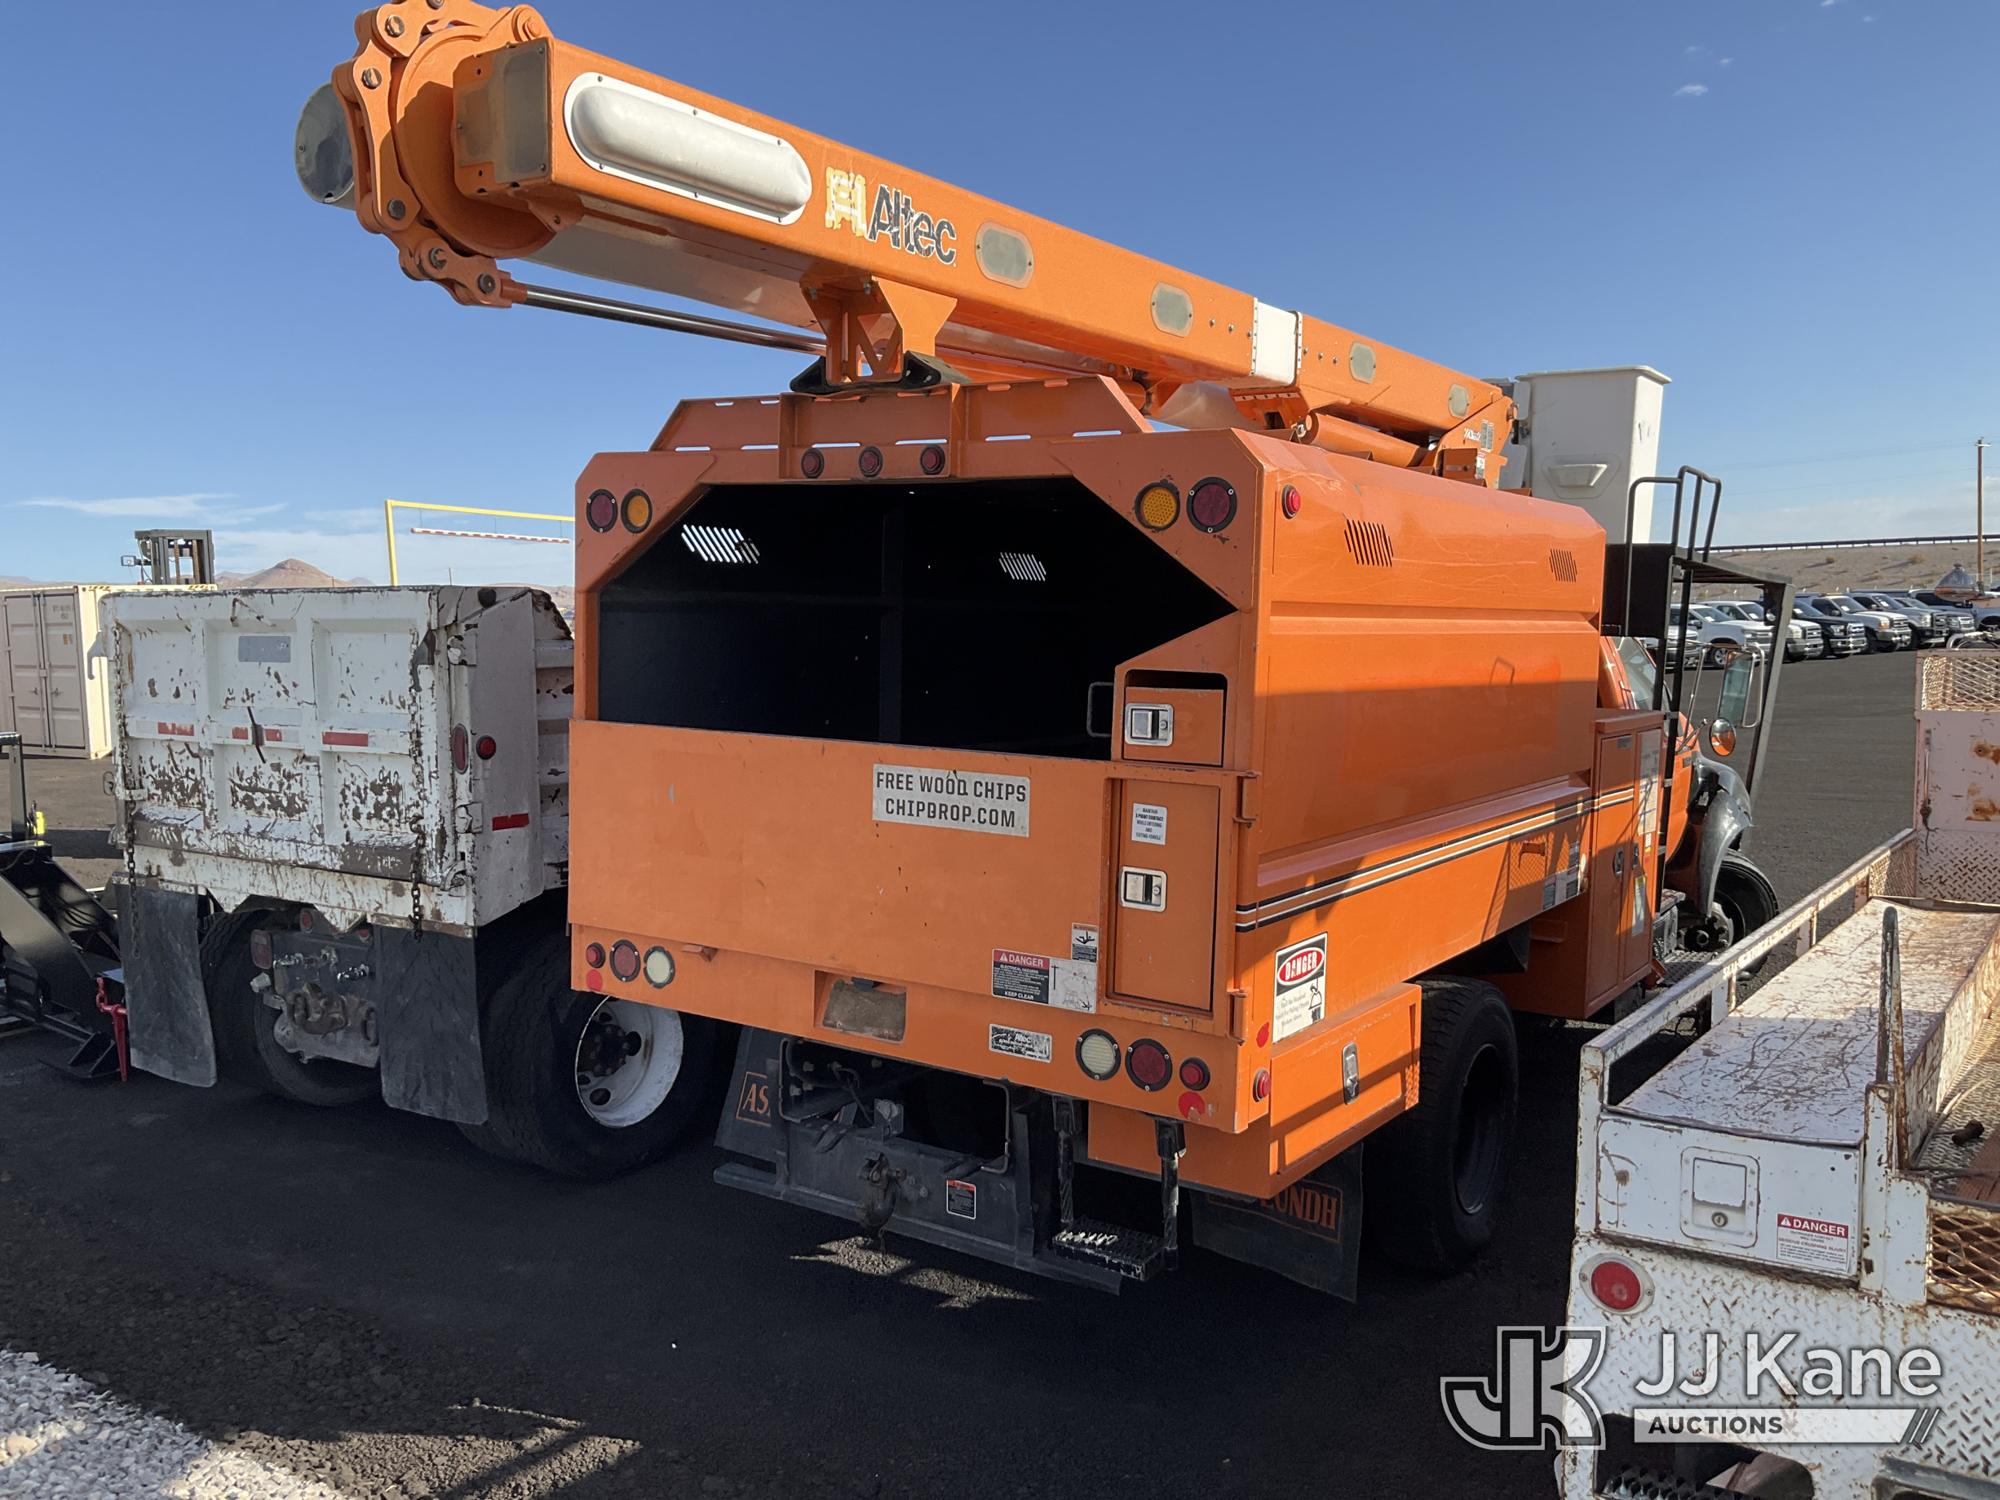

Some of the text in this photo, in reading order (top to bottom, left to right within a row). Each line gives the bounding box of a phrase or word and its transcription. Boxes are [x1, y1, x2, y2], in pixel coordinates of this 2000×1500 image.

[867, 184, 957, 265] Altec
[876, 772, 1026, 802] FREE WOOD CHIPS
[885, 798, 1015, 828] CHIPDROP.COM
[1008, 953, 1044, 968] DANGER
[1284, 951, 1318, 981] DANGER
[1262, 1186, 1338, 1230] UNDH
[1793, 1218, 1845, 1236] DANGER
